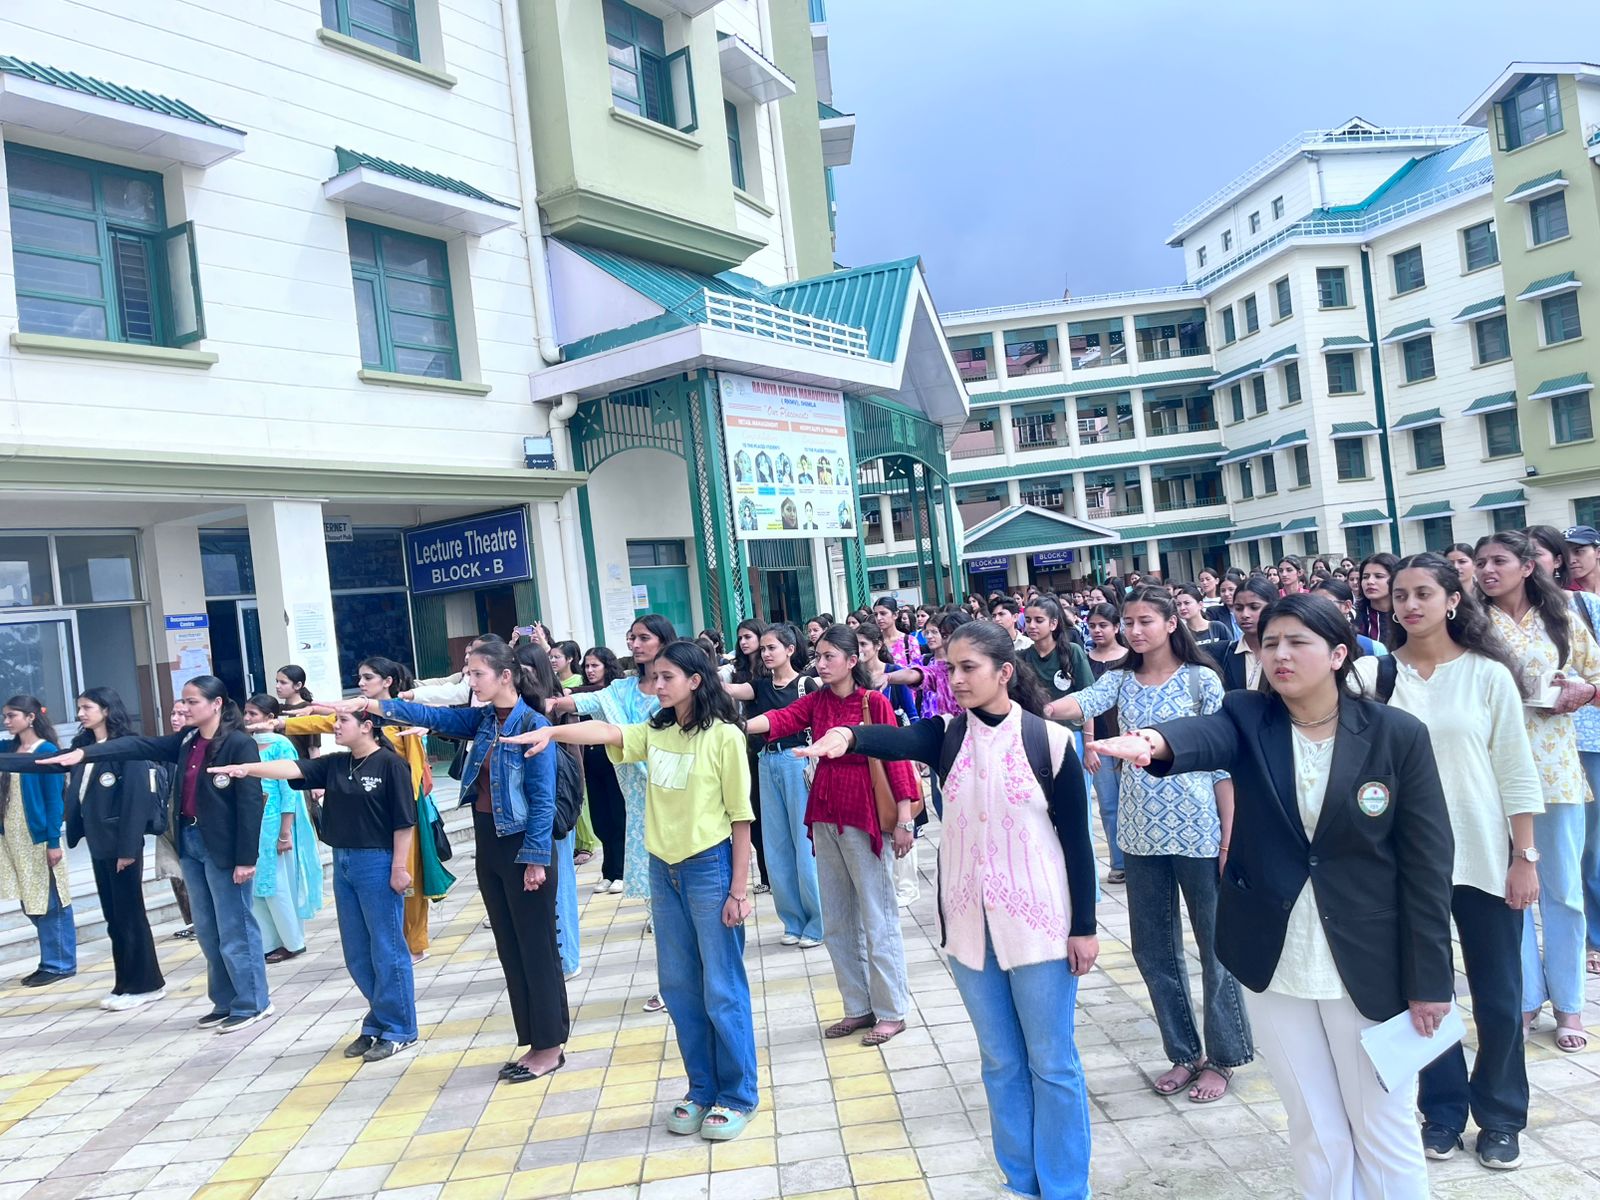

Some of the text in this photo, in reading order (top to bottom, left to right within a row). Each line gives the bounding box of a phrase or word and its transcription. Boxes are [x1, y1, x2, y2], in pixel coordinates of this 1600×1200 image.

[752, 381, 778, 396] RAJKIYA
[778, 384, 799, 398] KANYA
[415, 526, 517, 565] Lecture Theatre
[1039, 551, 1068, 560] BLOCK-C
[431, 562, 482, 584] BLOCK
[493, 558, 504, 574] B
